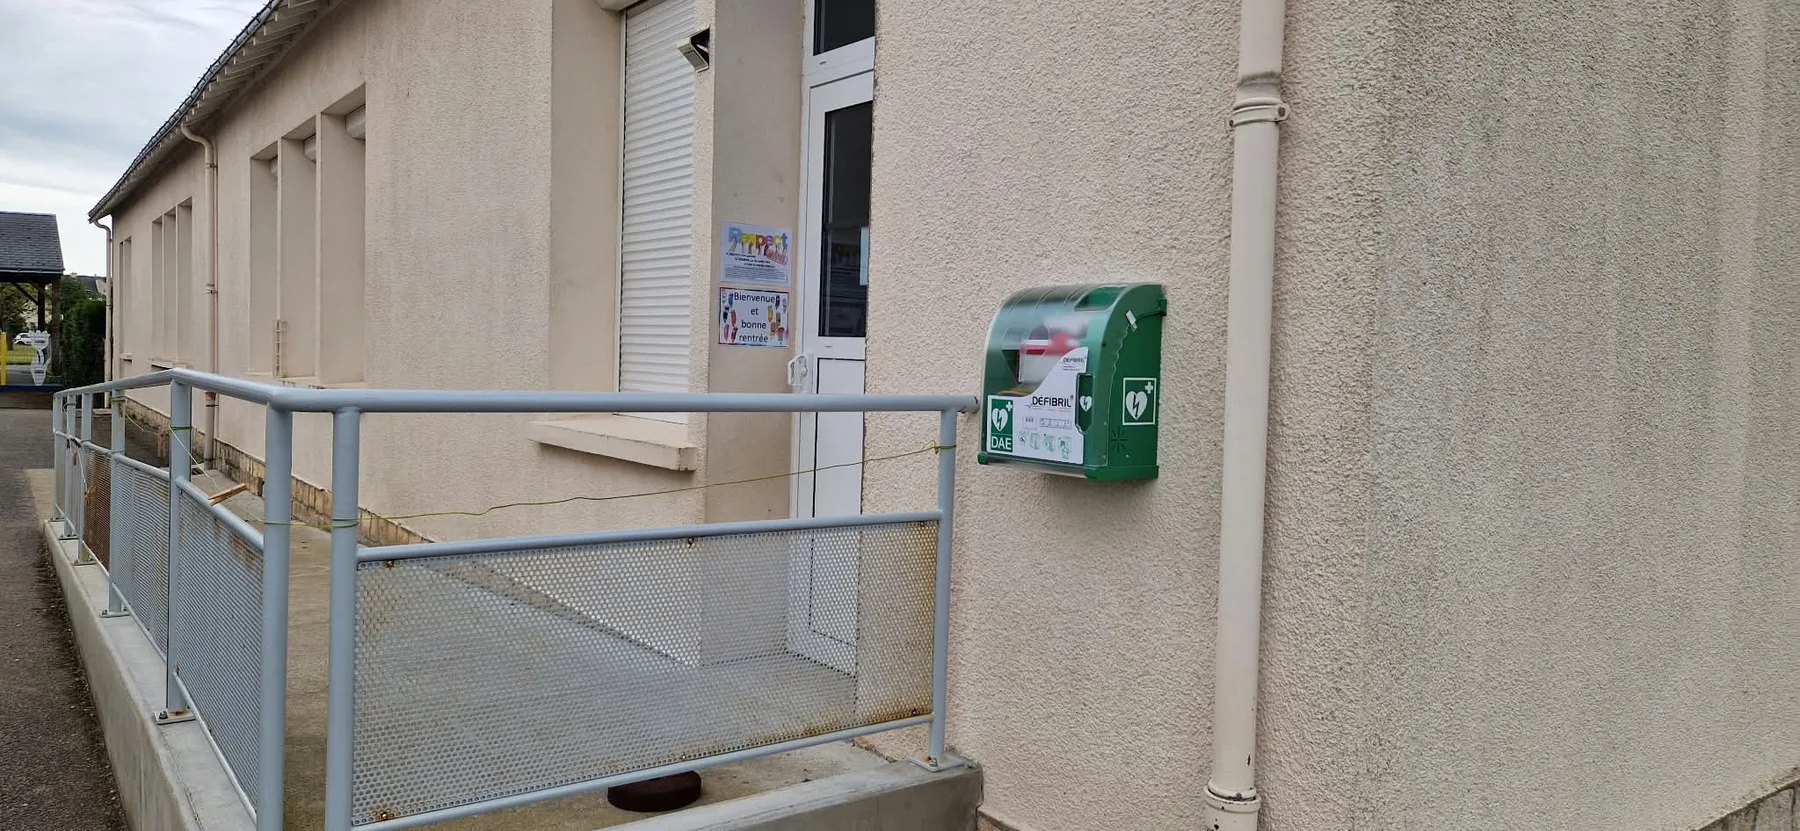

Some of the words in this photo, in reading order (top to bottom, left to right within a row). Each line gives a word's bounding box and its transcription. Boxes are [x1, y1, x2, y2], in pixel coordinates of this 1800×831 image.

[728, 227, 788, 250] Respect
[734, 292, 776, 303] Bienvenue
[750, 307, 759, 316] et
[741, 319, 767, 330] bonne
[739, 333, 769, 343] rentrée
[991, 436, 1012, 450] DAE
